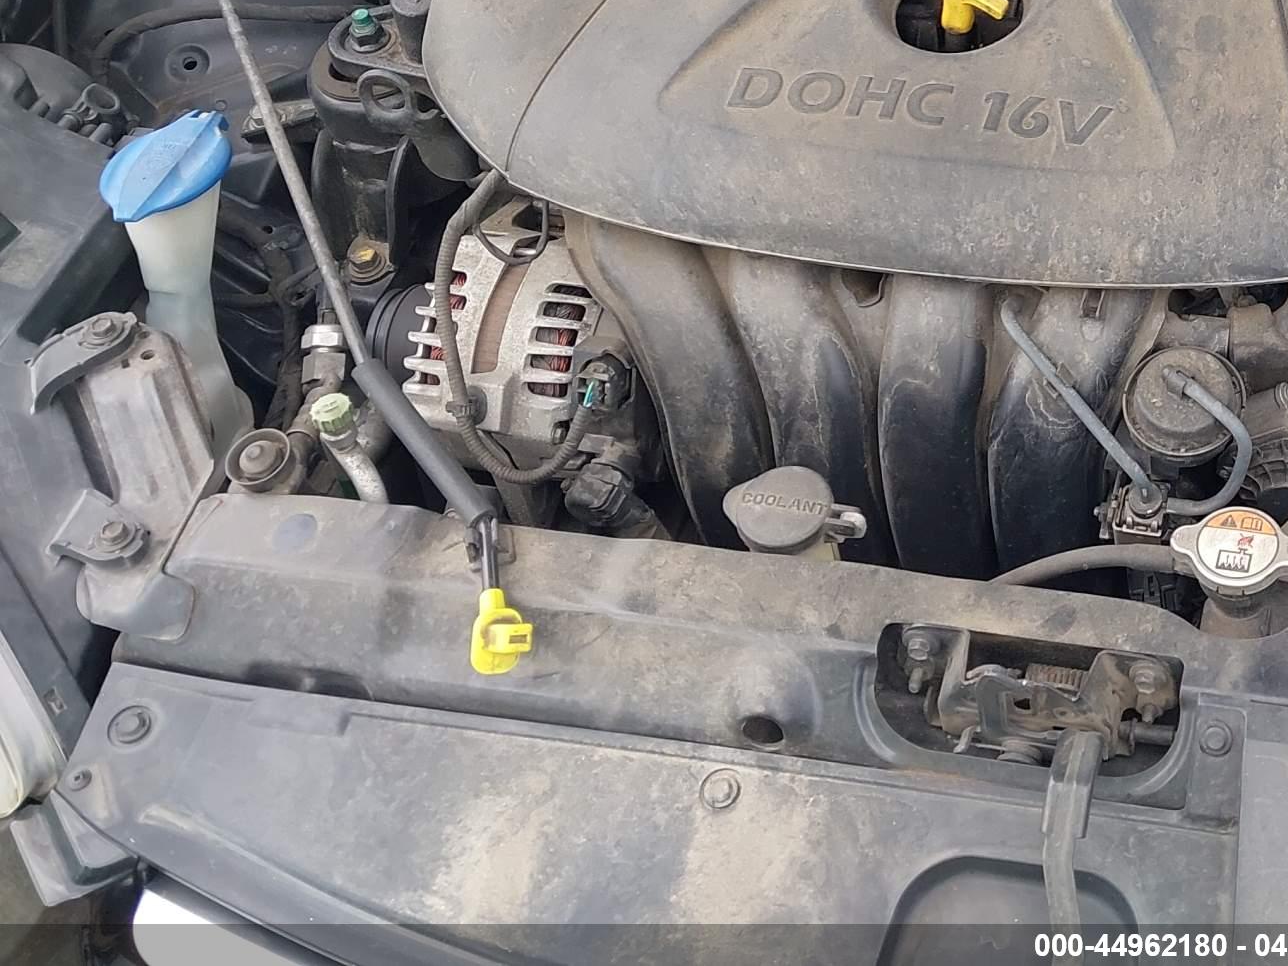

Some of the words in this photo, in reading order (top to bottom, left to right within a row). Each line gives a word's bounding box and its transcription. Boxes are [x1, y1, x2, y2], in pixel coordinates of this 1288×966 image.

[726, 65, 955, 128] DOHC
[980, 89, 1114, 148] 16V
[741, 492, 828, 516] COOLANT
